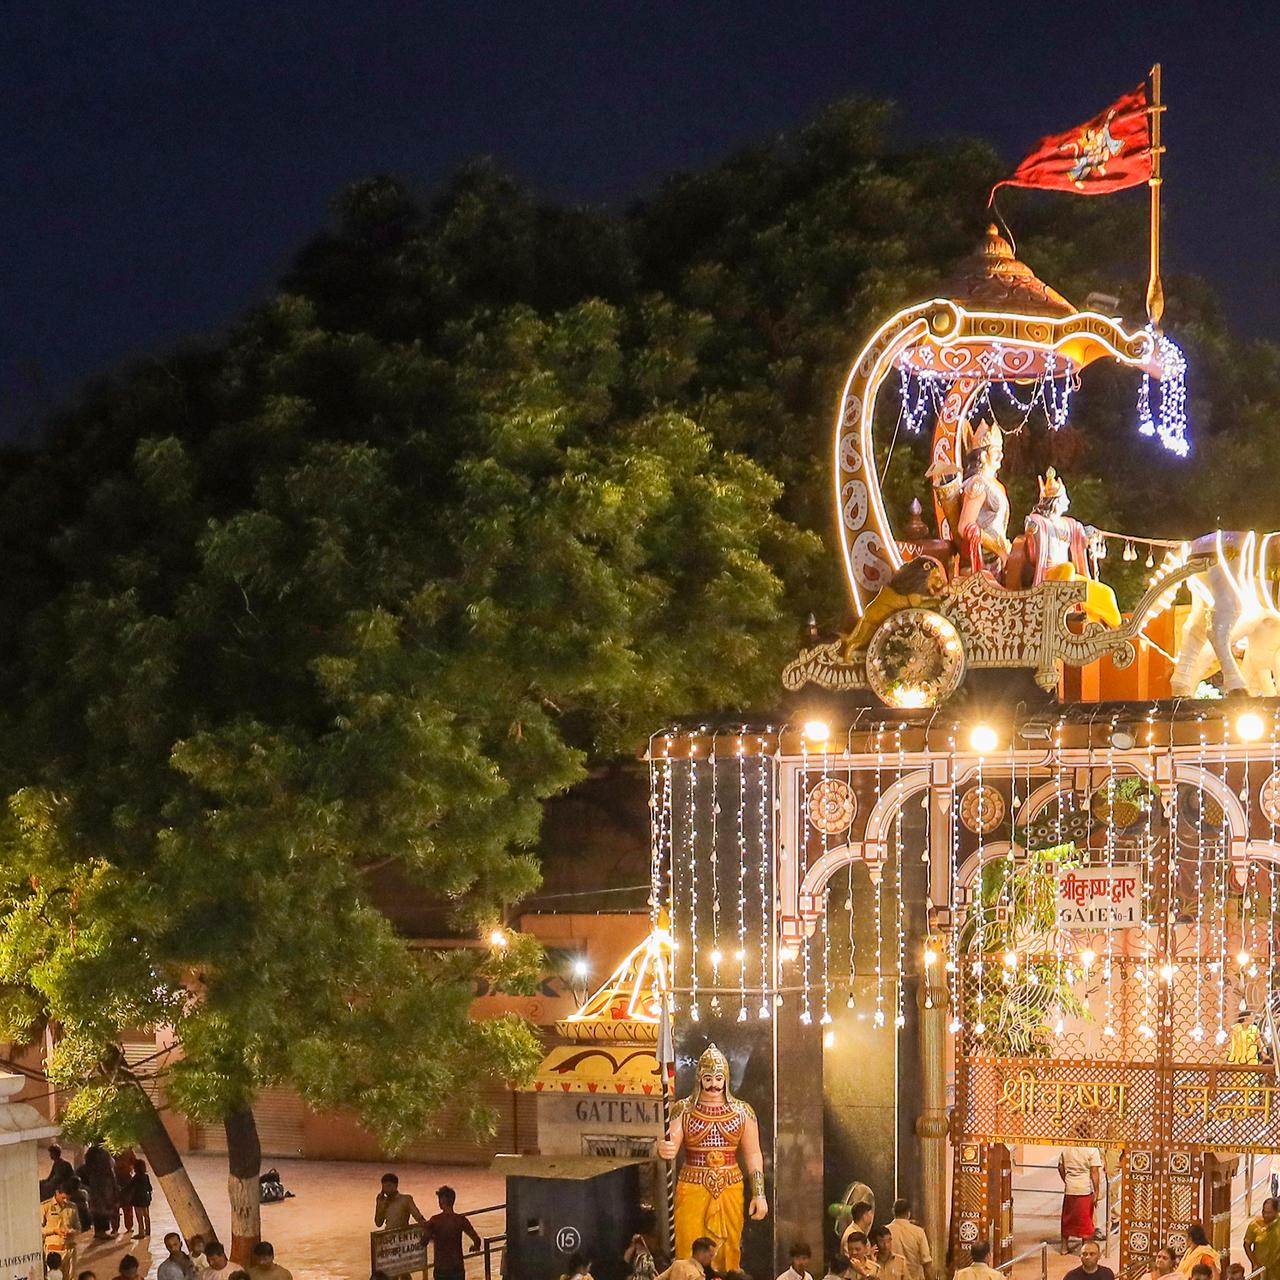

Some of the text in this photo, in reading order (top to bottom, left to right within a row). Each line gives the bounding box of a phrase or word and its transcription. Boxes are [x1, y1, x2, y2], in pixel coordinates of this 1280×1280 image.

[1060, 907, 1108, 923] GATE
[996, 1069, 1132, 1128] श्रीकृष्ण
[575, 1101, 634, 1124] GATE
[560, 1232, 575, 1248] 15
